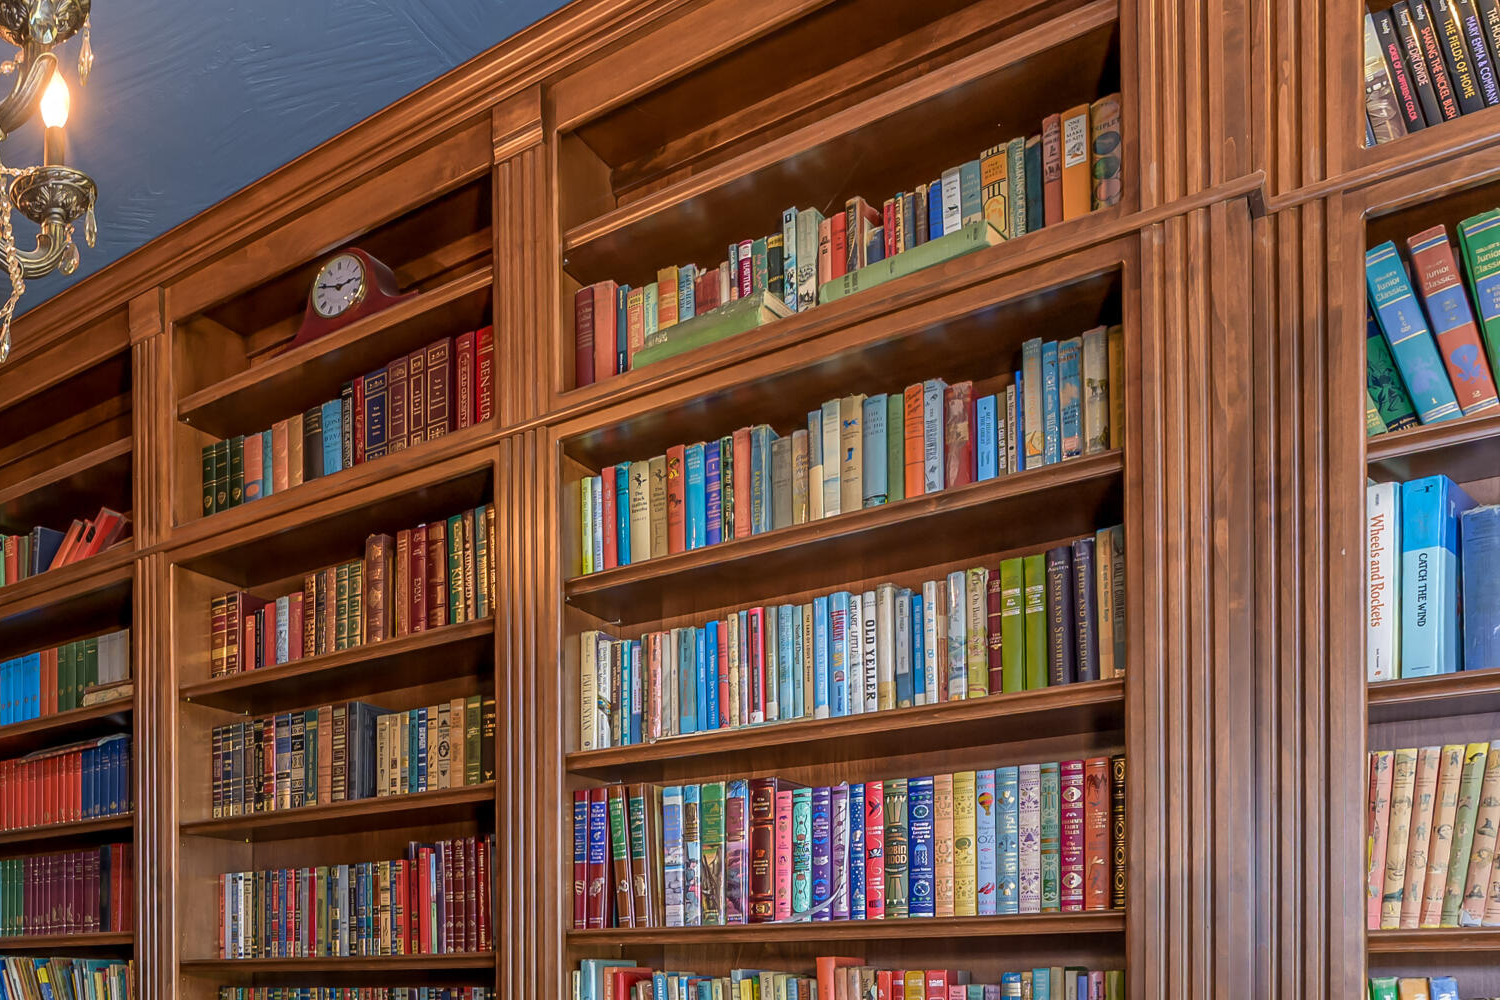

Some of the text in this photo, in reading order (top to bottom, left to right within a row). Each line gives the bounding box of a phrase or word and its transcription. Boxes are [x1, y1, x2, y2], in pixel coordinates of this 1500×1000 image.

[1487, 9, 1498, 24] THE
[1405, 36, 1429, 87] THE DRY DIVIDE
[1421, 27, 1458, 120] SHAKING THE NICKEL BUSH
[1444, 18, 1476, 100] THE FIELDS OF HOME
[1465, 15, 1499, 106] MARY EMMA & COMPANY
[1375, 285, 1408, 301] Classics
[1376, 277, 1400, 291] Junior
[480, 359, 491, 423] BEN-HUR
[452, 566, 461, 594] KIM
[1370, 513, 1384, 627] Wheels and Rockets
[1417, 553, 1428, 627] CATCH THE WIND
[1053, 574, 1064, 683] SENSE AND SENSIBILITY
[1078, 565, 1089, 672] PRIDE AND PREJUDICE
[583, 674, 592, 694] PAUL
[865, 620, 876, 702] OLD YELLER
[1035, 972, 1046, 992] THE
